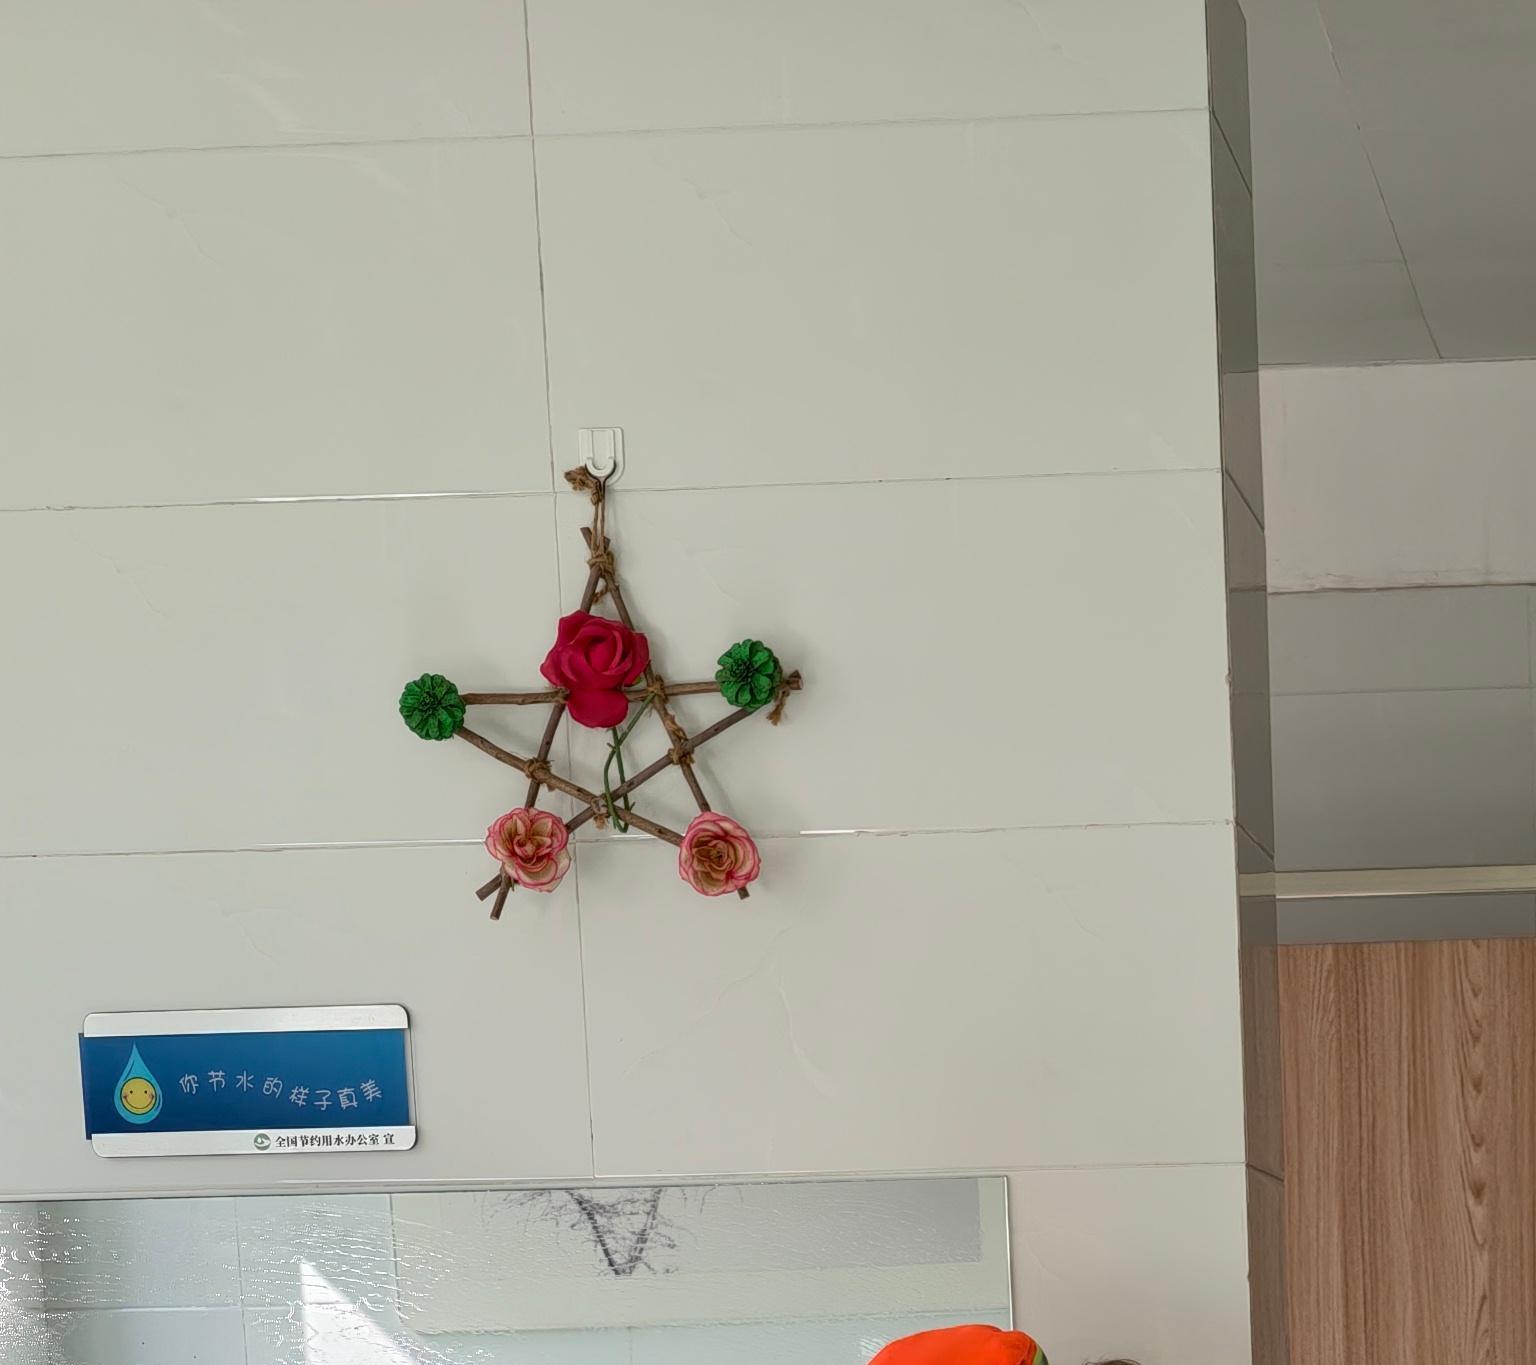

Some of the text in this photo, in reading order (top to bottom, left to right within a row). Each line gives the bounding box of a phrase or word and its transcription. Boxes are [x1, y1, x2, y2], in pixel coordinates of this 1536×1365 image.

[178, 1069, 383, 1111] 你节水的样子真美
[275, 1134, 380, 1148] 全国节约用水办公室
